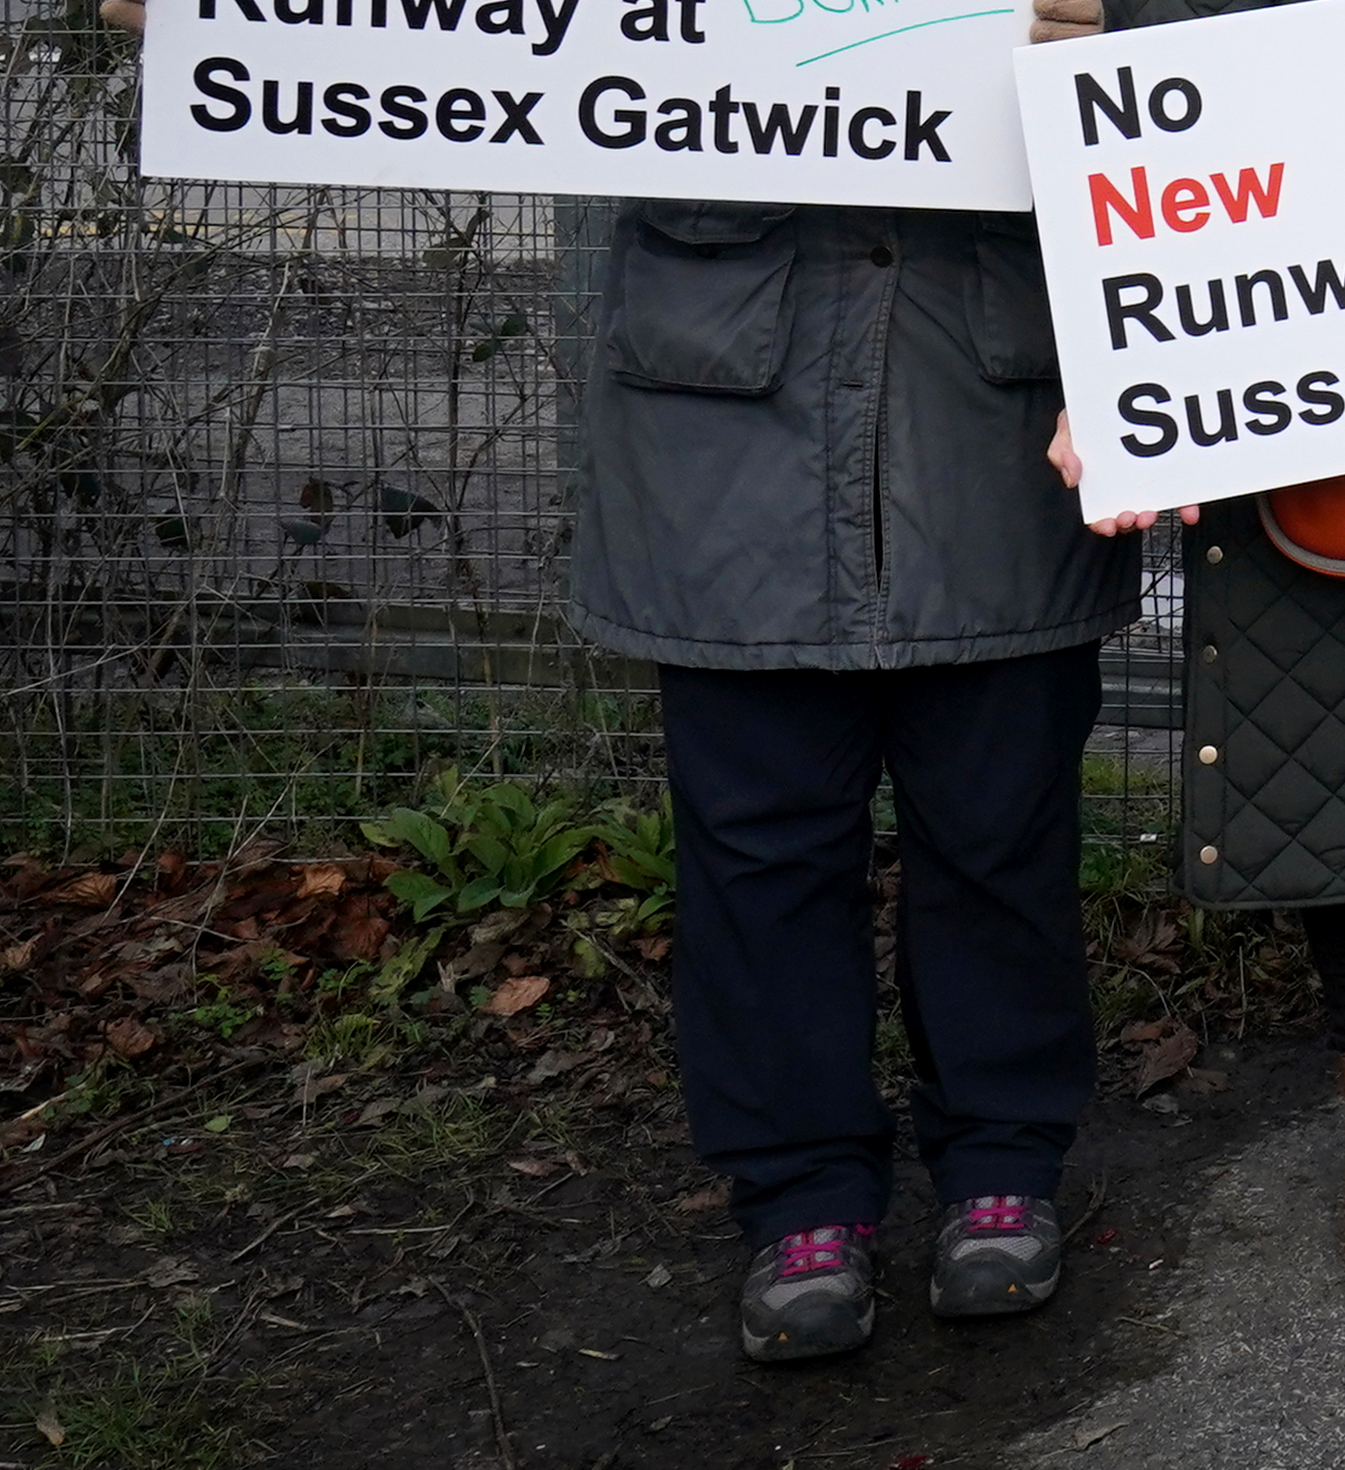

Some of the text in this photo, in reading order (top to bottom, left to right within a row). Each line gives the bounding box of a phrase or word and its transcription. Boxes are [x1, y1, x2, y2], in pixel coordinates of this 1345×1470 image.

[190, 57, 953, 163] Sussex Gatwick
[1074, 66, 1203, 146] No
[1087, 162, 1285, 247] New
